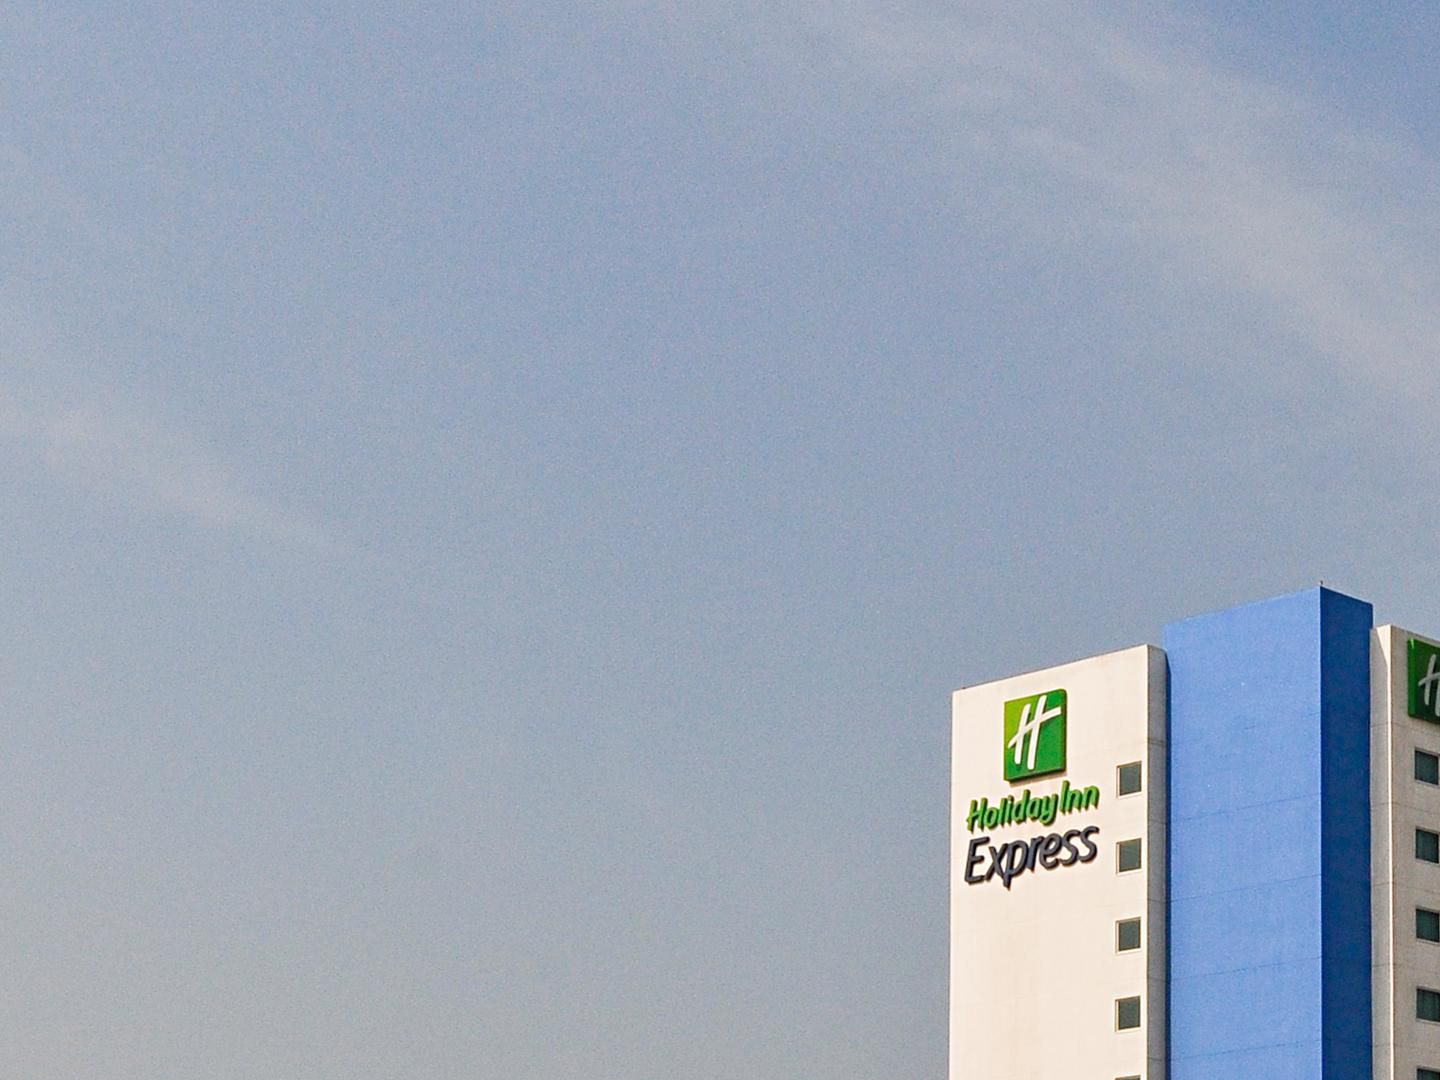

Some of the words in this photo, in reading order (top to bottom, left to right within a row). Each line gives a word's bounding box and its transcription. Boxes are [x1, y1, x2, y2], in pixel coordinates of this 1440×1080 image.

[966, 788, 1059, 834] Holiday
[1059, 780, 1100, 815] Inn
[964, 825, 1100, 891] Express
